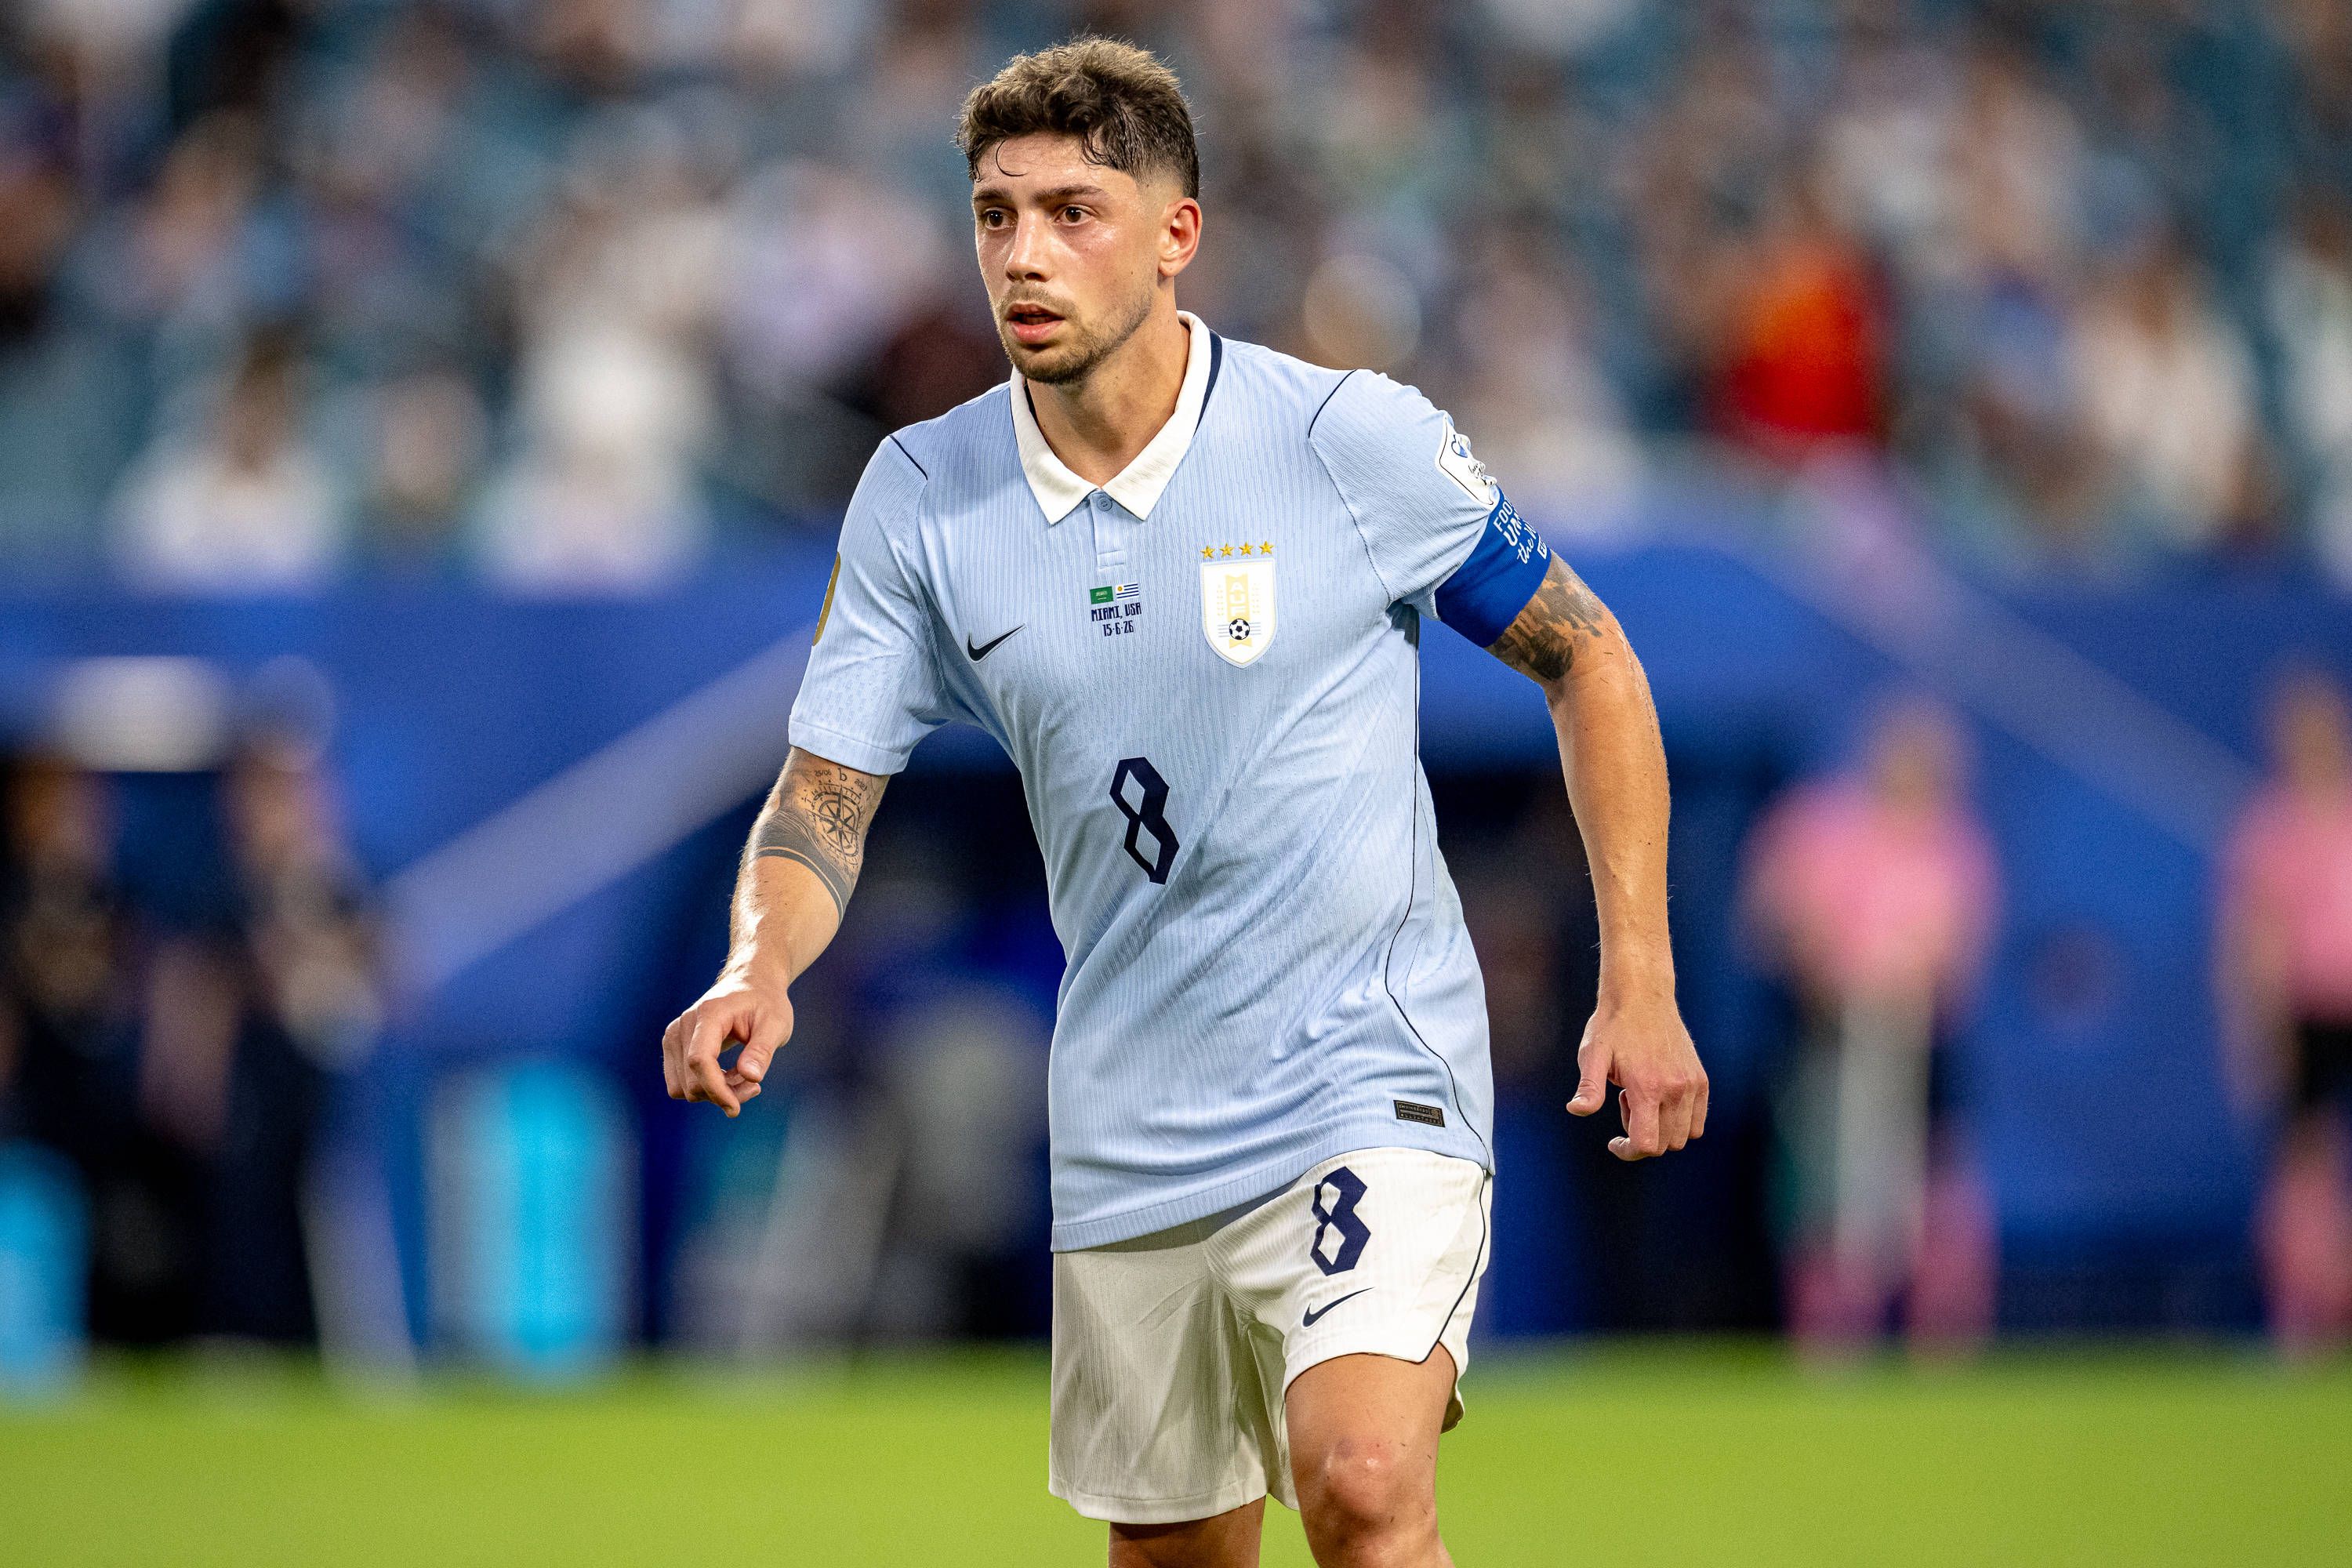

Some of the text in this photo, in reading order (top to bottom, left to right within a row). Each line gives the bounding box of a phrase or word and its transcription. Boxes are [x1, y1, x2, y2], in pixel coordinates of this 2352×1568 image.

[1493, 499, 1516, 533] FOO
[1091, 602, 1142, 622] MIAMI, USA
[1229, 582, 1246, 617] AUF
[837, 768, 848, 782] b
[1109, 757, 1180, 885] 8
[1310, 1166, 1371, 1276] 8
